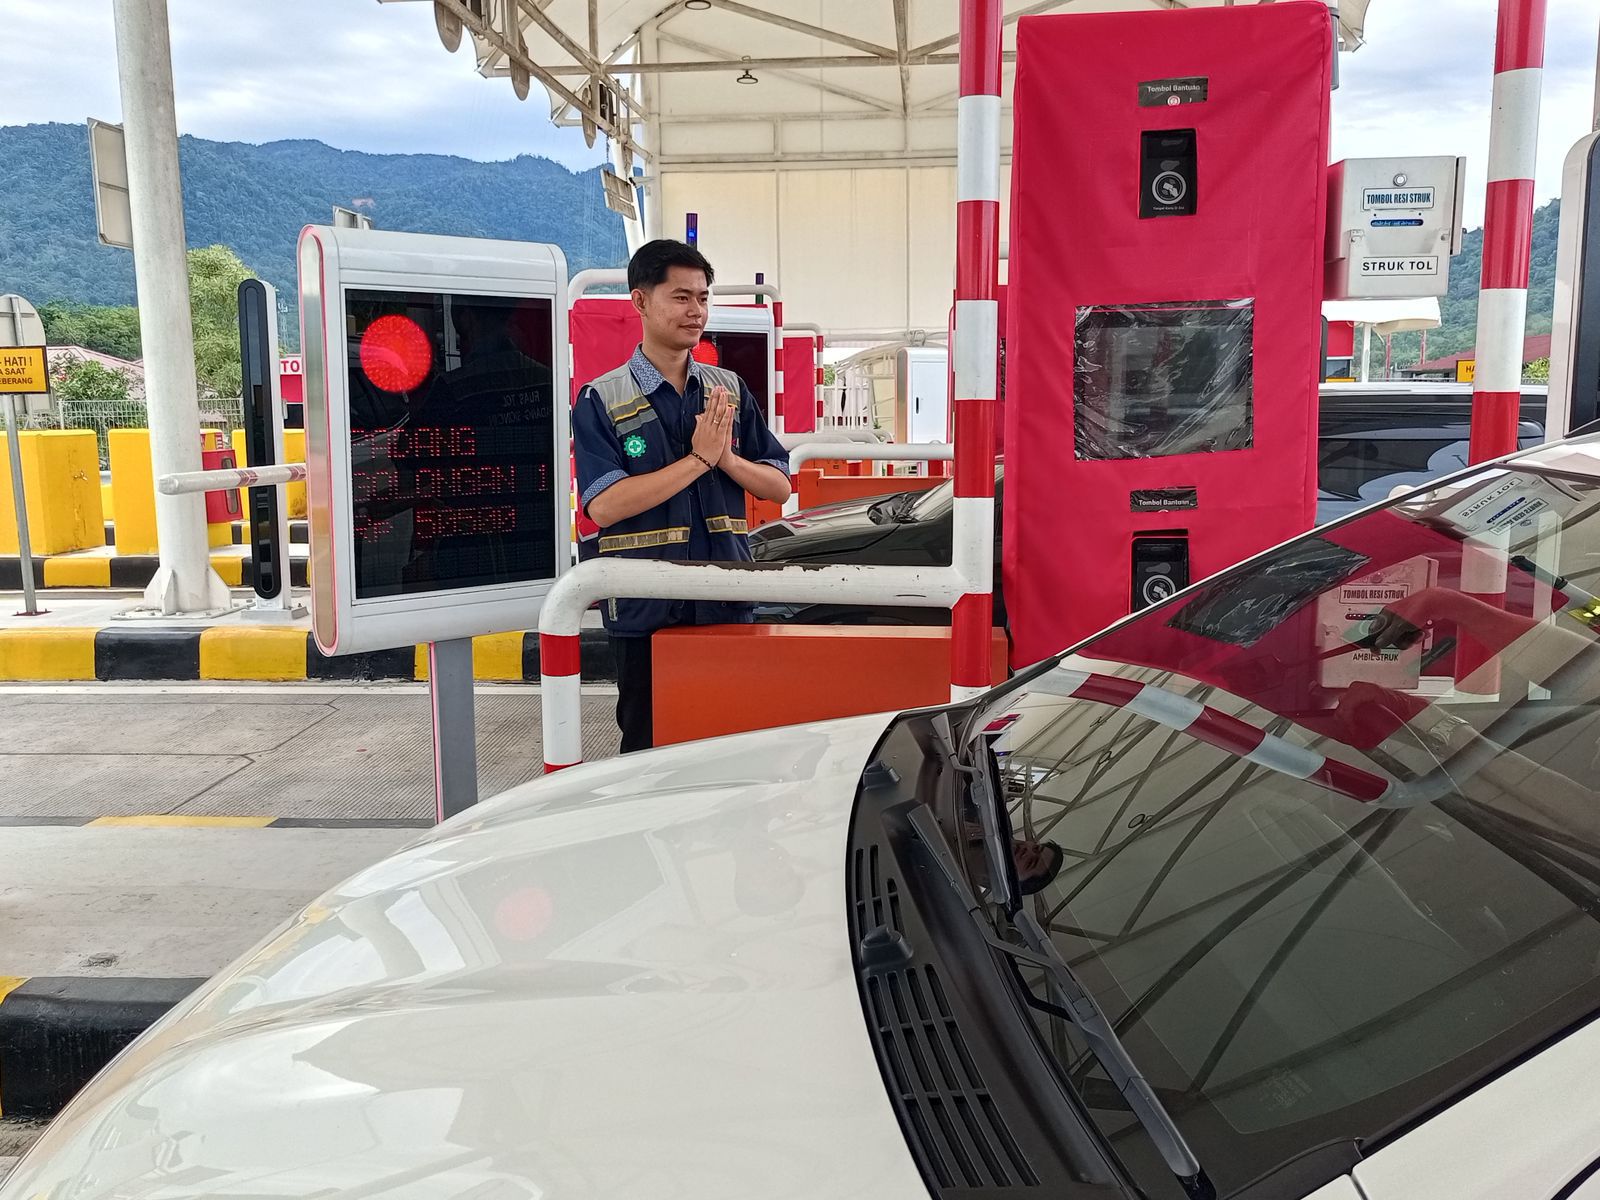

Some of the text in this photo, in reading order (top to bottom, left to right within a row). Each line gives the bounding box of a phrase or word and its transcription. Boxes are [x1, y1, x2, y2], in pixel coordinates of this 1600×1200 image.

[1147, 85, 1172, 93] Tombol
[1366, 192, 1431, 205] TOMBOL RESI STRUK
[1362, 261, 1433, 271] STRUK TOL
[4, 356, 26, 366] HATI
[5, 367, 26, 376] SAAT
[538, 464, 549, 491] 1
[1343, 589, 1405, 599] TOMBOL RESI STRUK
[1376, 653, 1399, 661] STRUK
